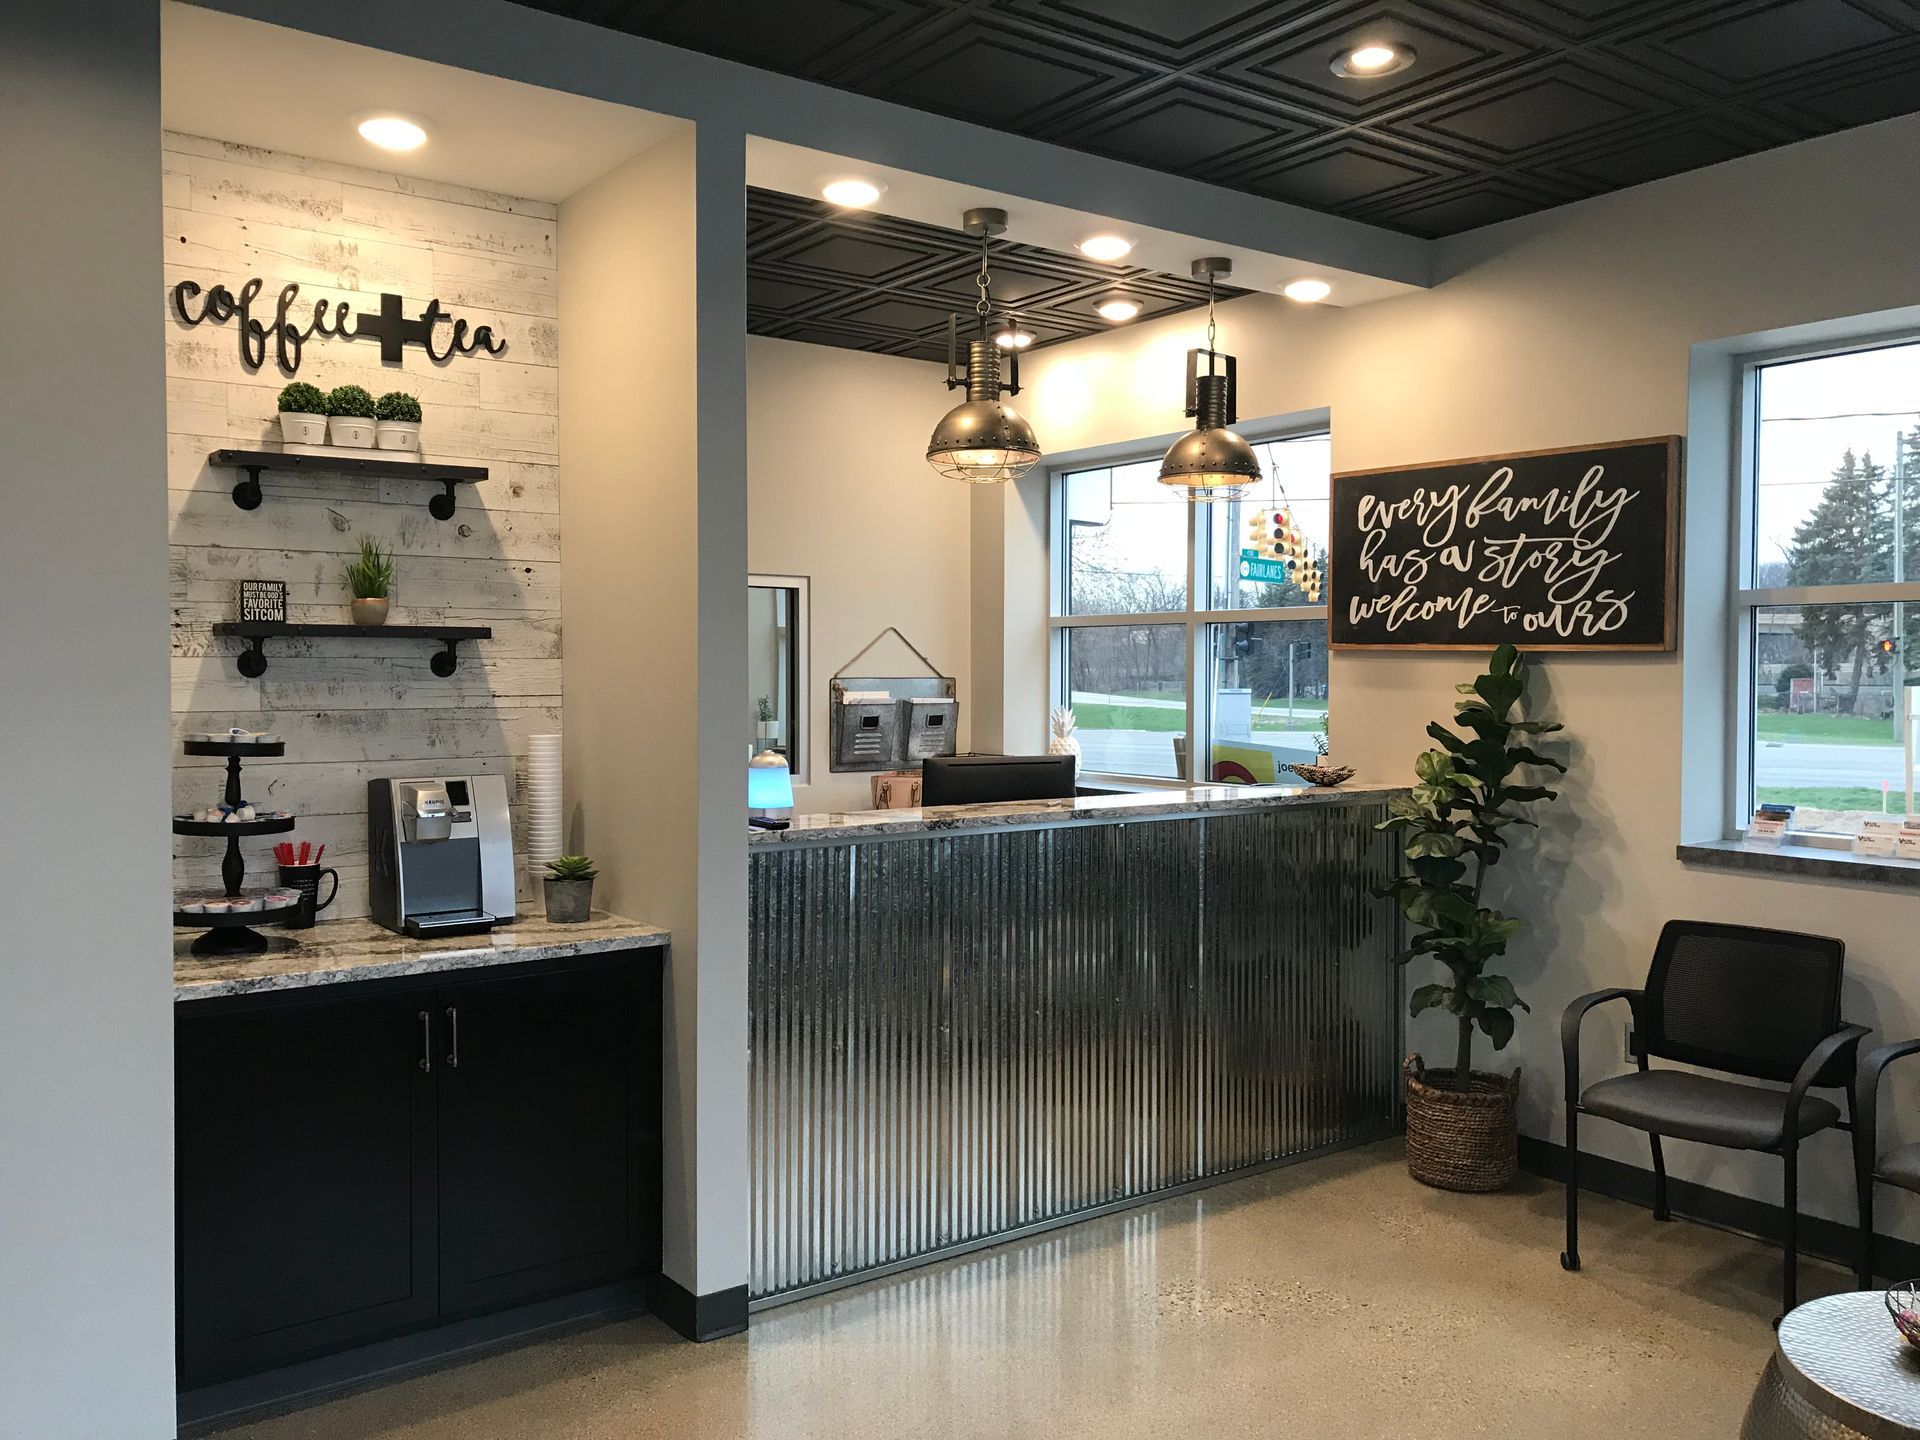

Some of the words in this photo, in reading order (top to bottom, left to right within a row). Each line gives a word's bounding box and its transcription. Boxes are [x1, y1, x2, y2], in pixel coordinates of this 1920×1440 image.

[176, 278, 358, 373] coffee
[419, 298, 506, 361] tea
[1358, 484, 1470, 547] every
[1466, 465, 1640, 550] family
[1250, 562, 1282, 580] FAIRLANES
[1360, 528, 1437, 584] has
[1440, 539, 1476, 572] a
[1478, 533, 1623, 604] story
[243, 582, 258, 591] OUR
[258, 583, 284, 592] FAMILY
[243, 598, 284, 609] FAVORITE
[243, 608, 284, 621] SITCOM
[1350, 586, 1496, 632] welcome
[1491, 605, 1521, 625] to
[1523, 590, 1636, 637] ours
